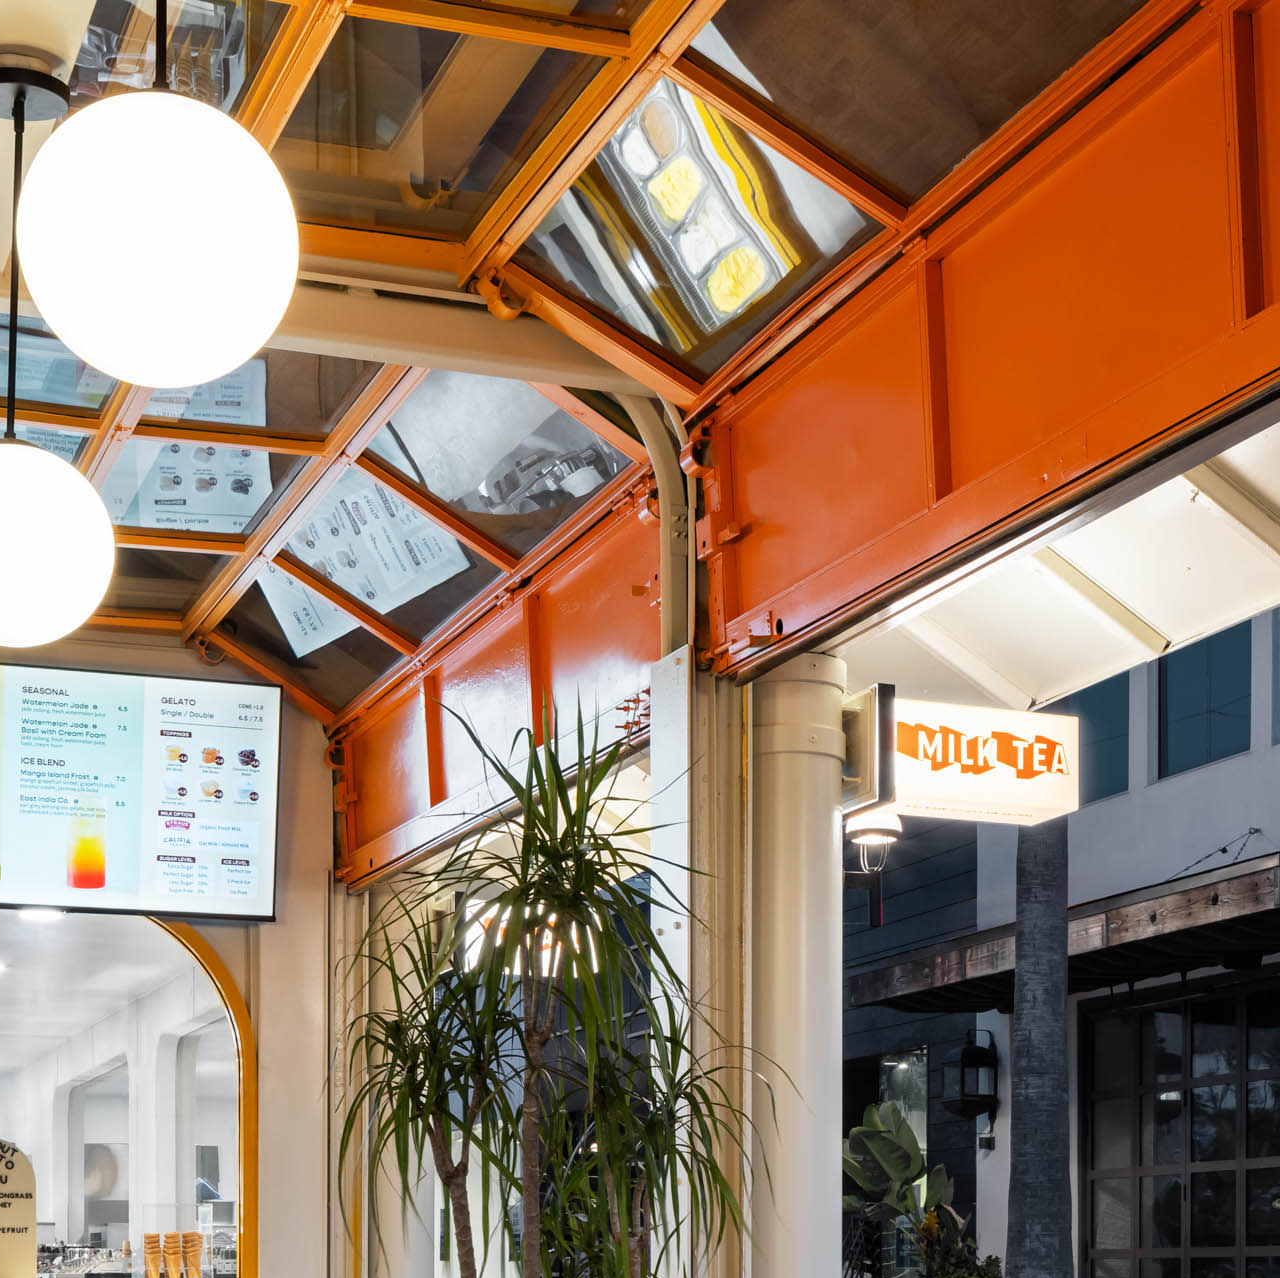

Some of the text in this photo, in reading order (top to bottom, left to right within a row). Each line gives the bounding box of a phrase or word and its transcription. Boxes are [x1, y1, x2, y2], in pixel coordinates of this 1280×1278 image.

[22, 686, 70, 697] SEASONAL
[22, 699, 89, 710] Watermelon Jade
[161, 696, 197, 706] GELATO
[160, 708, 183, 717] Single
[189, 711, 215, 719] Double
[21, 718, 89, 729] Watermelon Jade
[58, 729, 84, 737] Cream
[86, 731, 107, 739] Foam
[917, 729, 1071, 776] MILK TEA
[21, 757, 66, 767] ICE BLEND
[20, 769, 46, 778] Mango
[48, 771, 70, 779] Island
